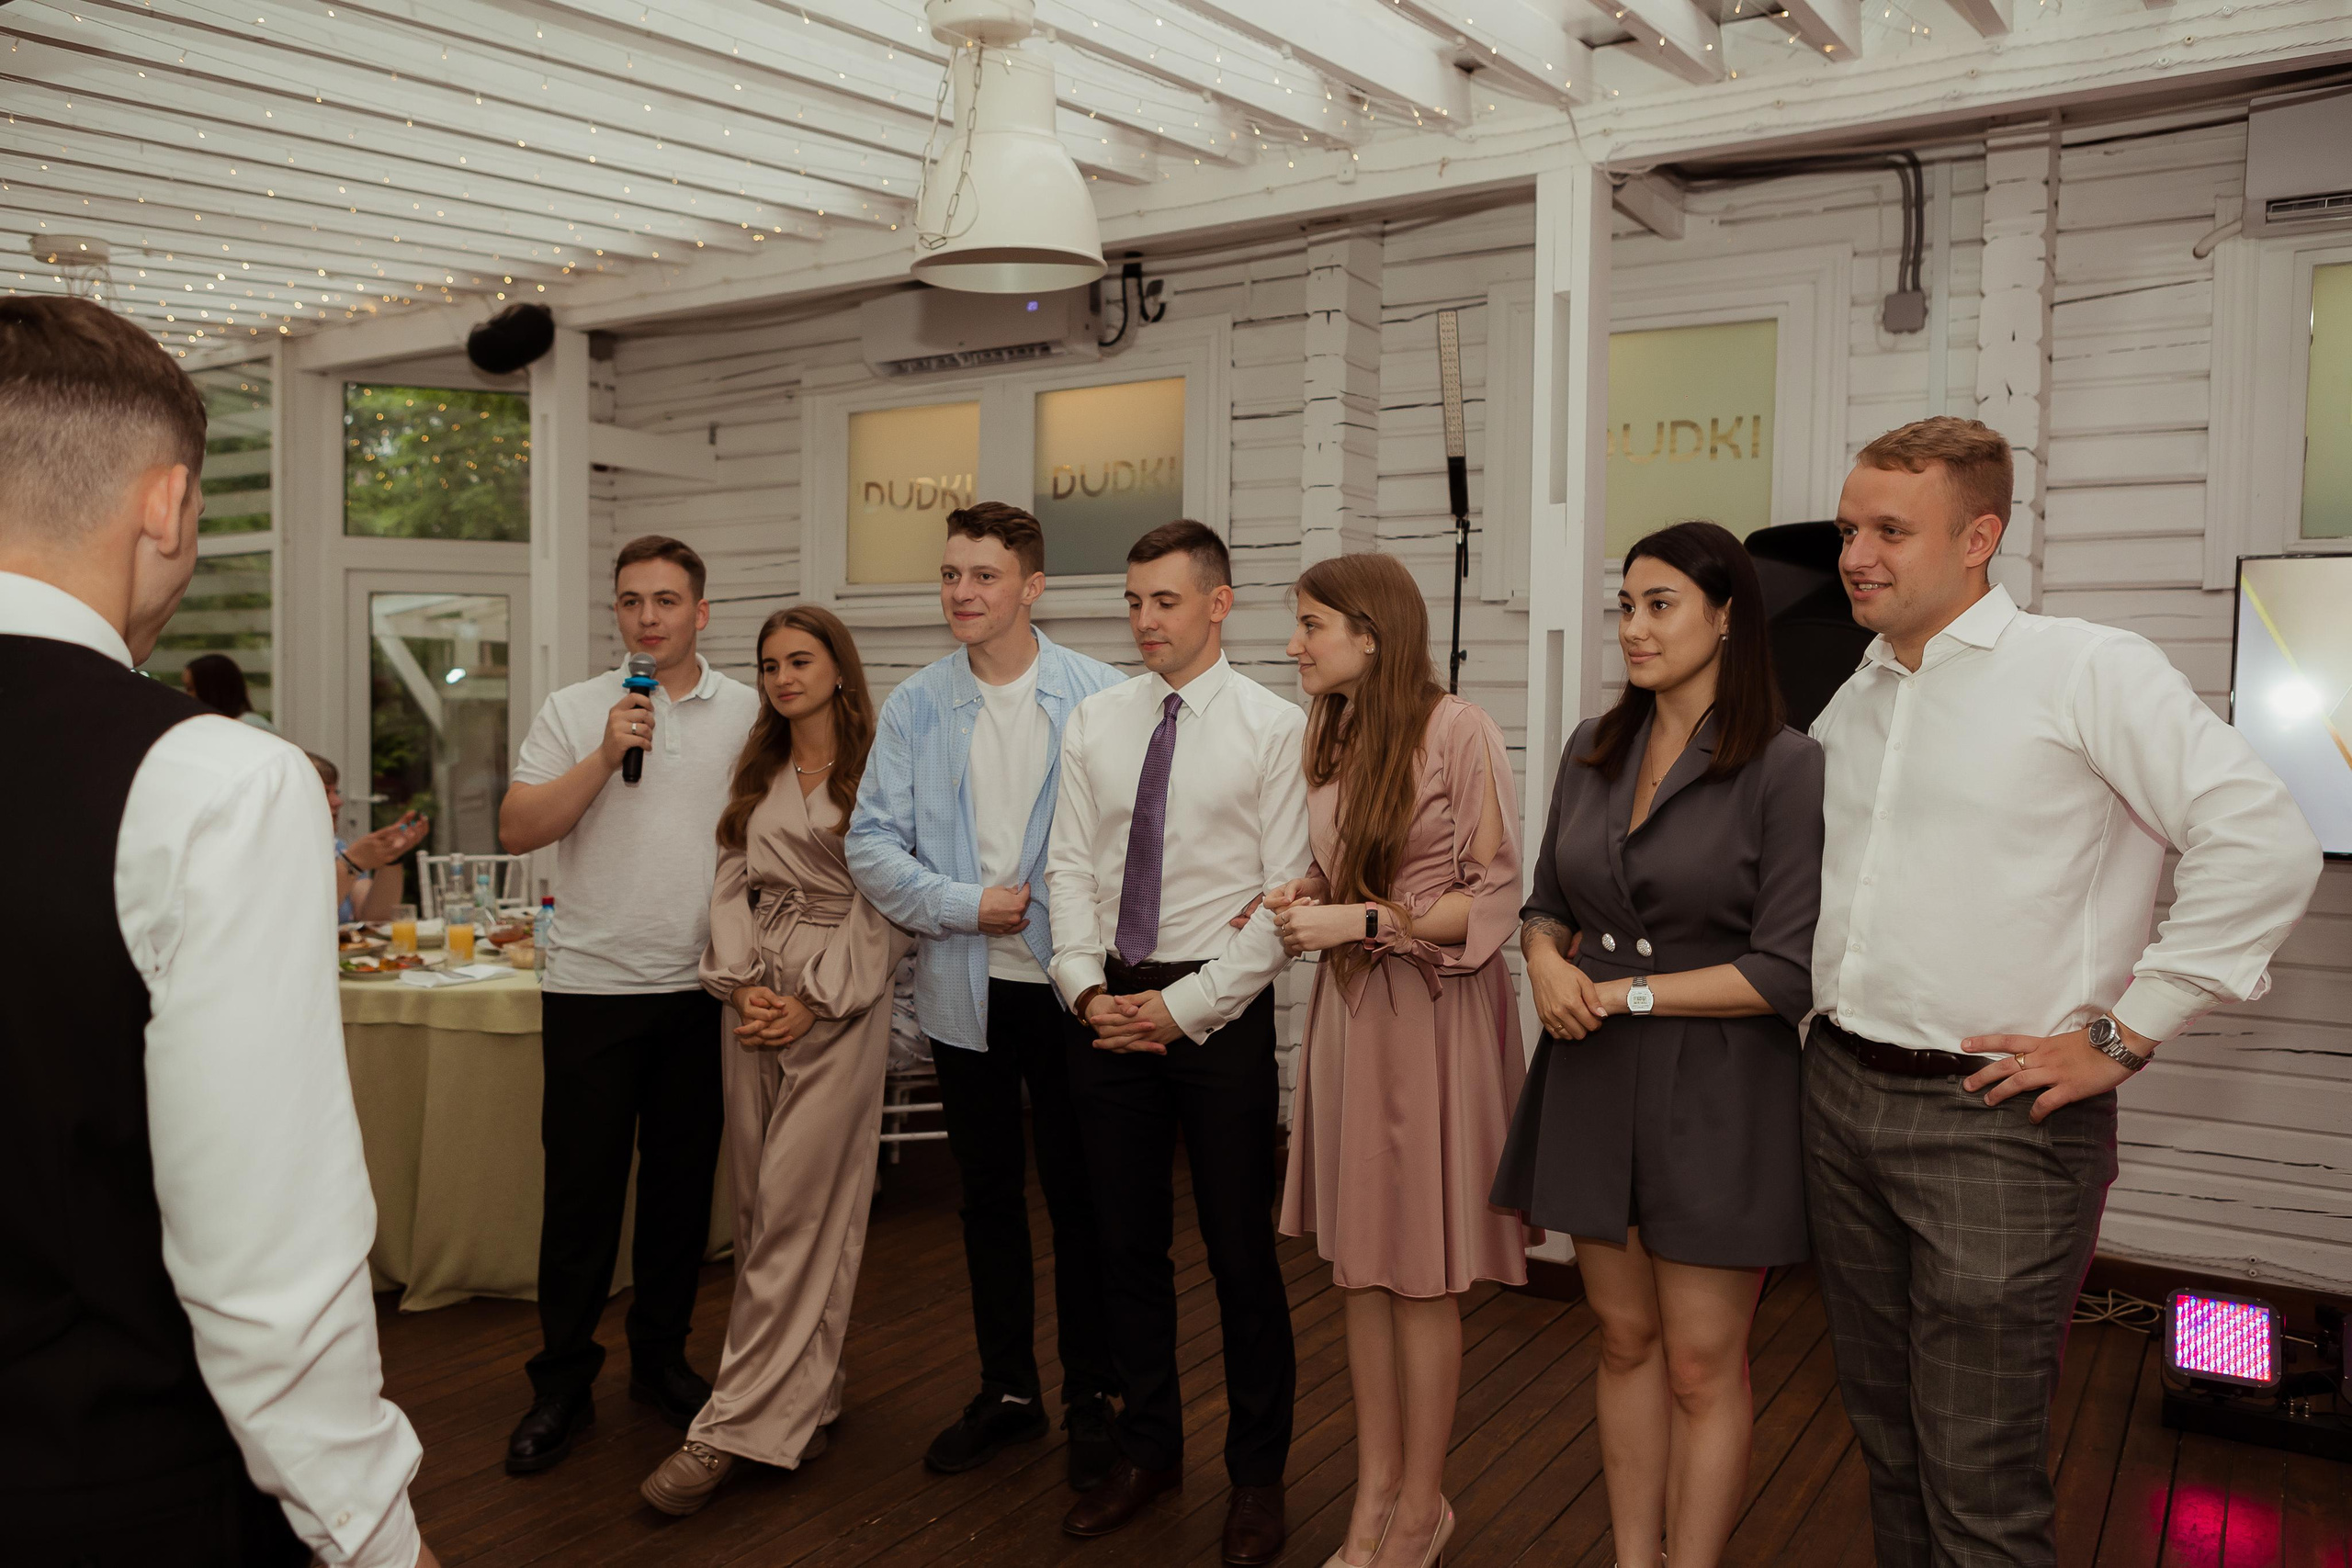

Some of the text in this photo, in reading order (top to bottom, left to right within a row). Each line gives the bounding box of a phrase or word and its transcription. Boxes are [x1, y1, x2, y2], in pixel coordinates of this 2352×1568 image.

[1607, 415, 1760, 464] UDKI
[864, 474, 972, 512] DUDKI
[1053, 457, 1176, 500] DUDKI
